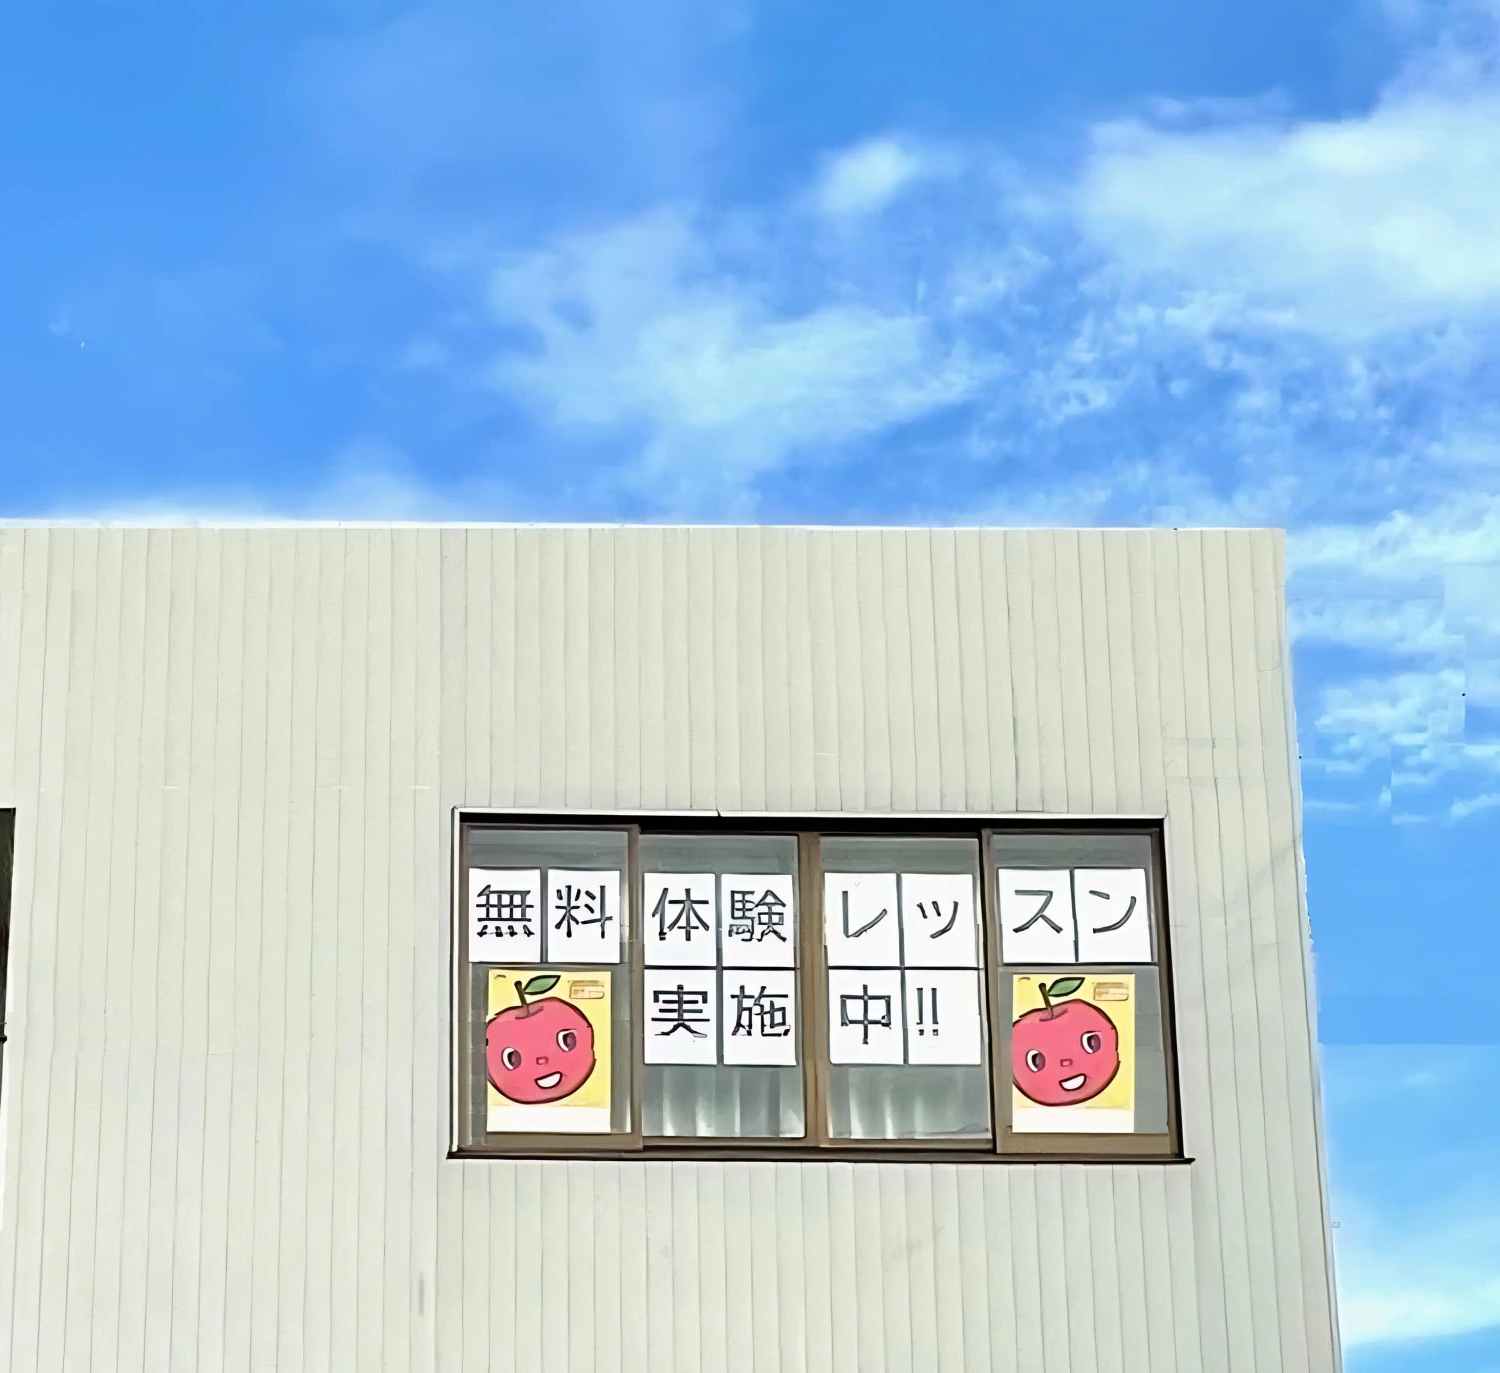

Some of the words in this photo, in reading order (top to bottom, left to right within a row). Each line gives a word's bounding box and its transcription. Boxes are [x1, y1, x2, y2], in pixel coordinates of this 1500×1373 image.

[475, 884, 1137, 942] 無料体験レッスン
